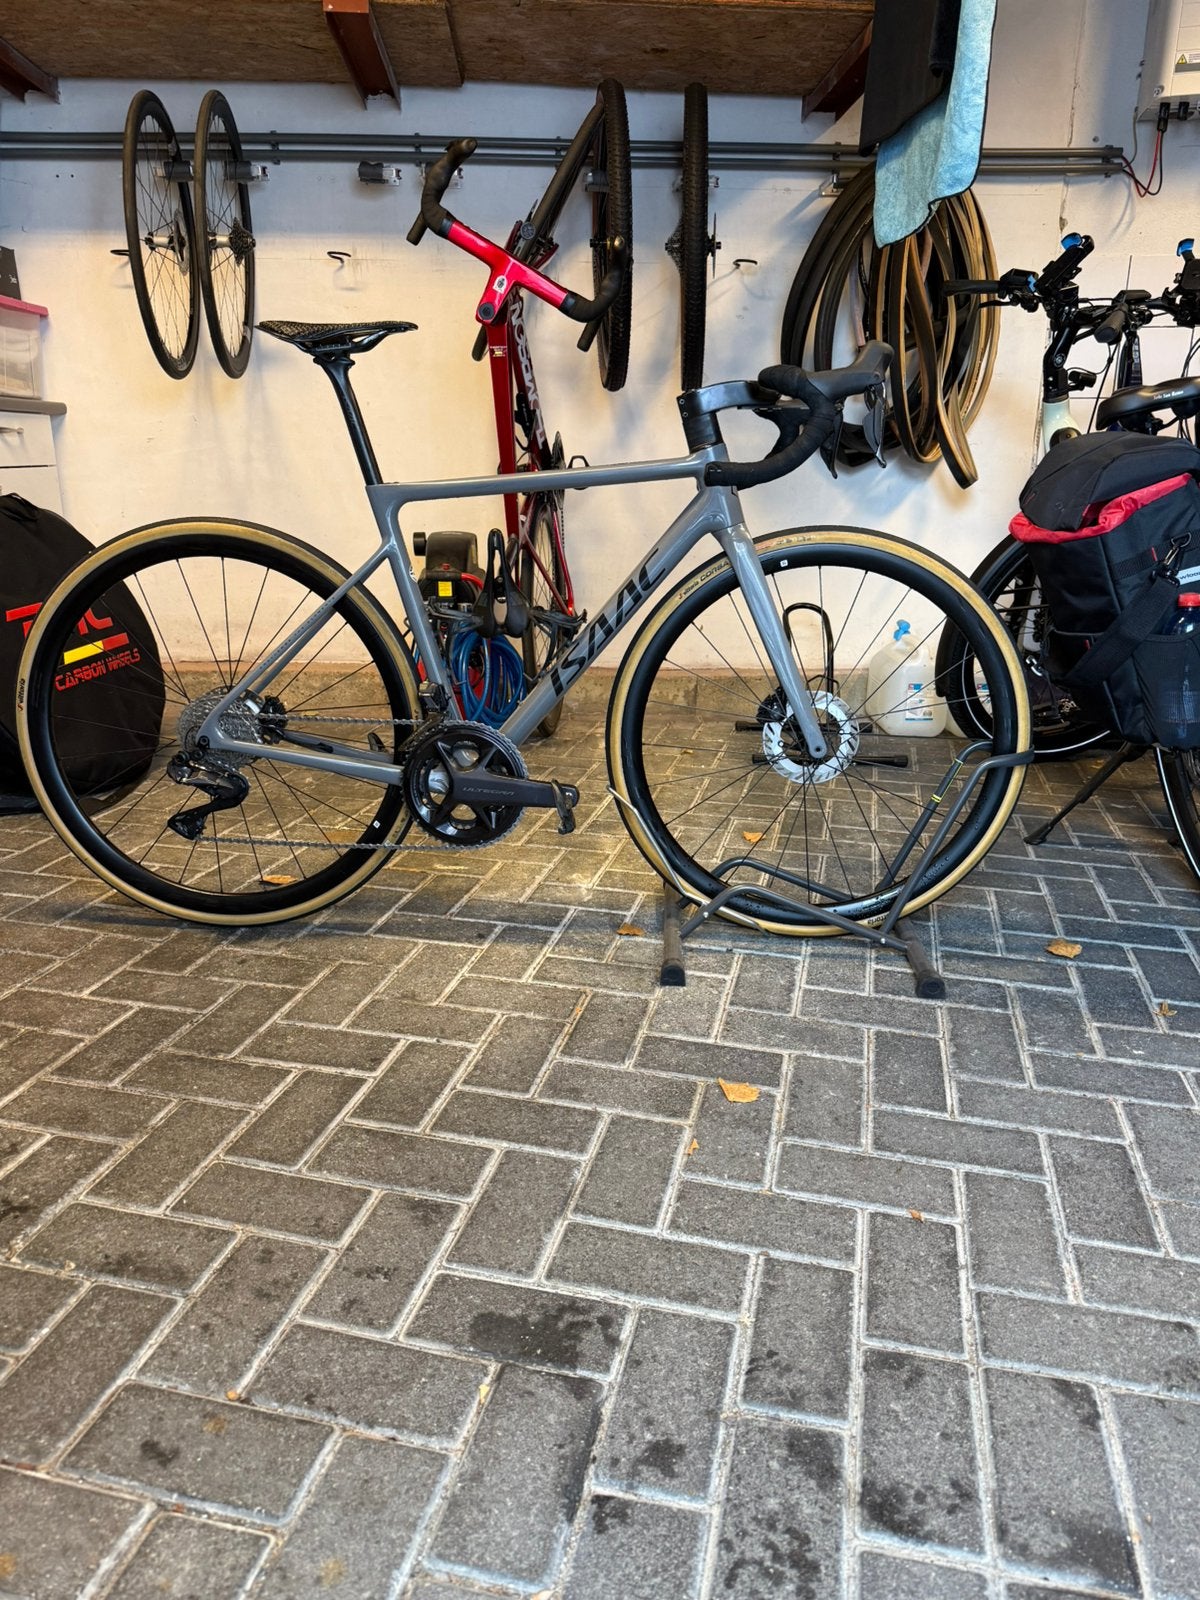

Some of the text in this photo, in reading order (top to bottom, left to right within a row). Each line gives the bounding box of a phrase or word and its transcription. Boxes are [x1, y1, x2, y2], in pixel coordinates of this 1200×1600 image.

[700, 561, 730, 582] CORSA
[551, 548, 666, 697] ISAAC
[55, 659, 107, 692] CARBON
[462, 786, 515, 796] ULTEGRA
